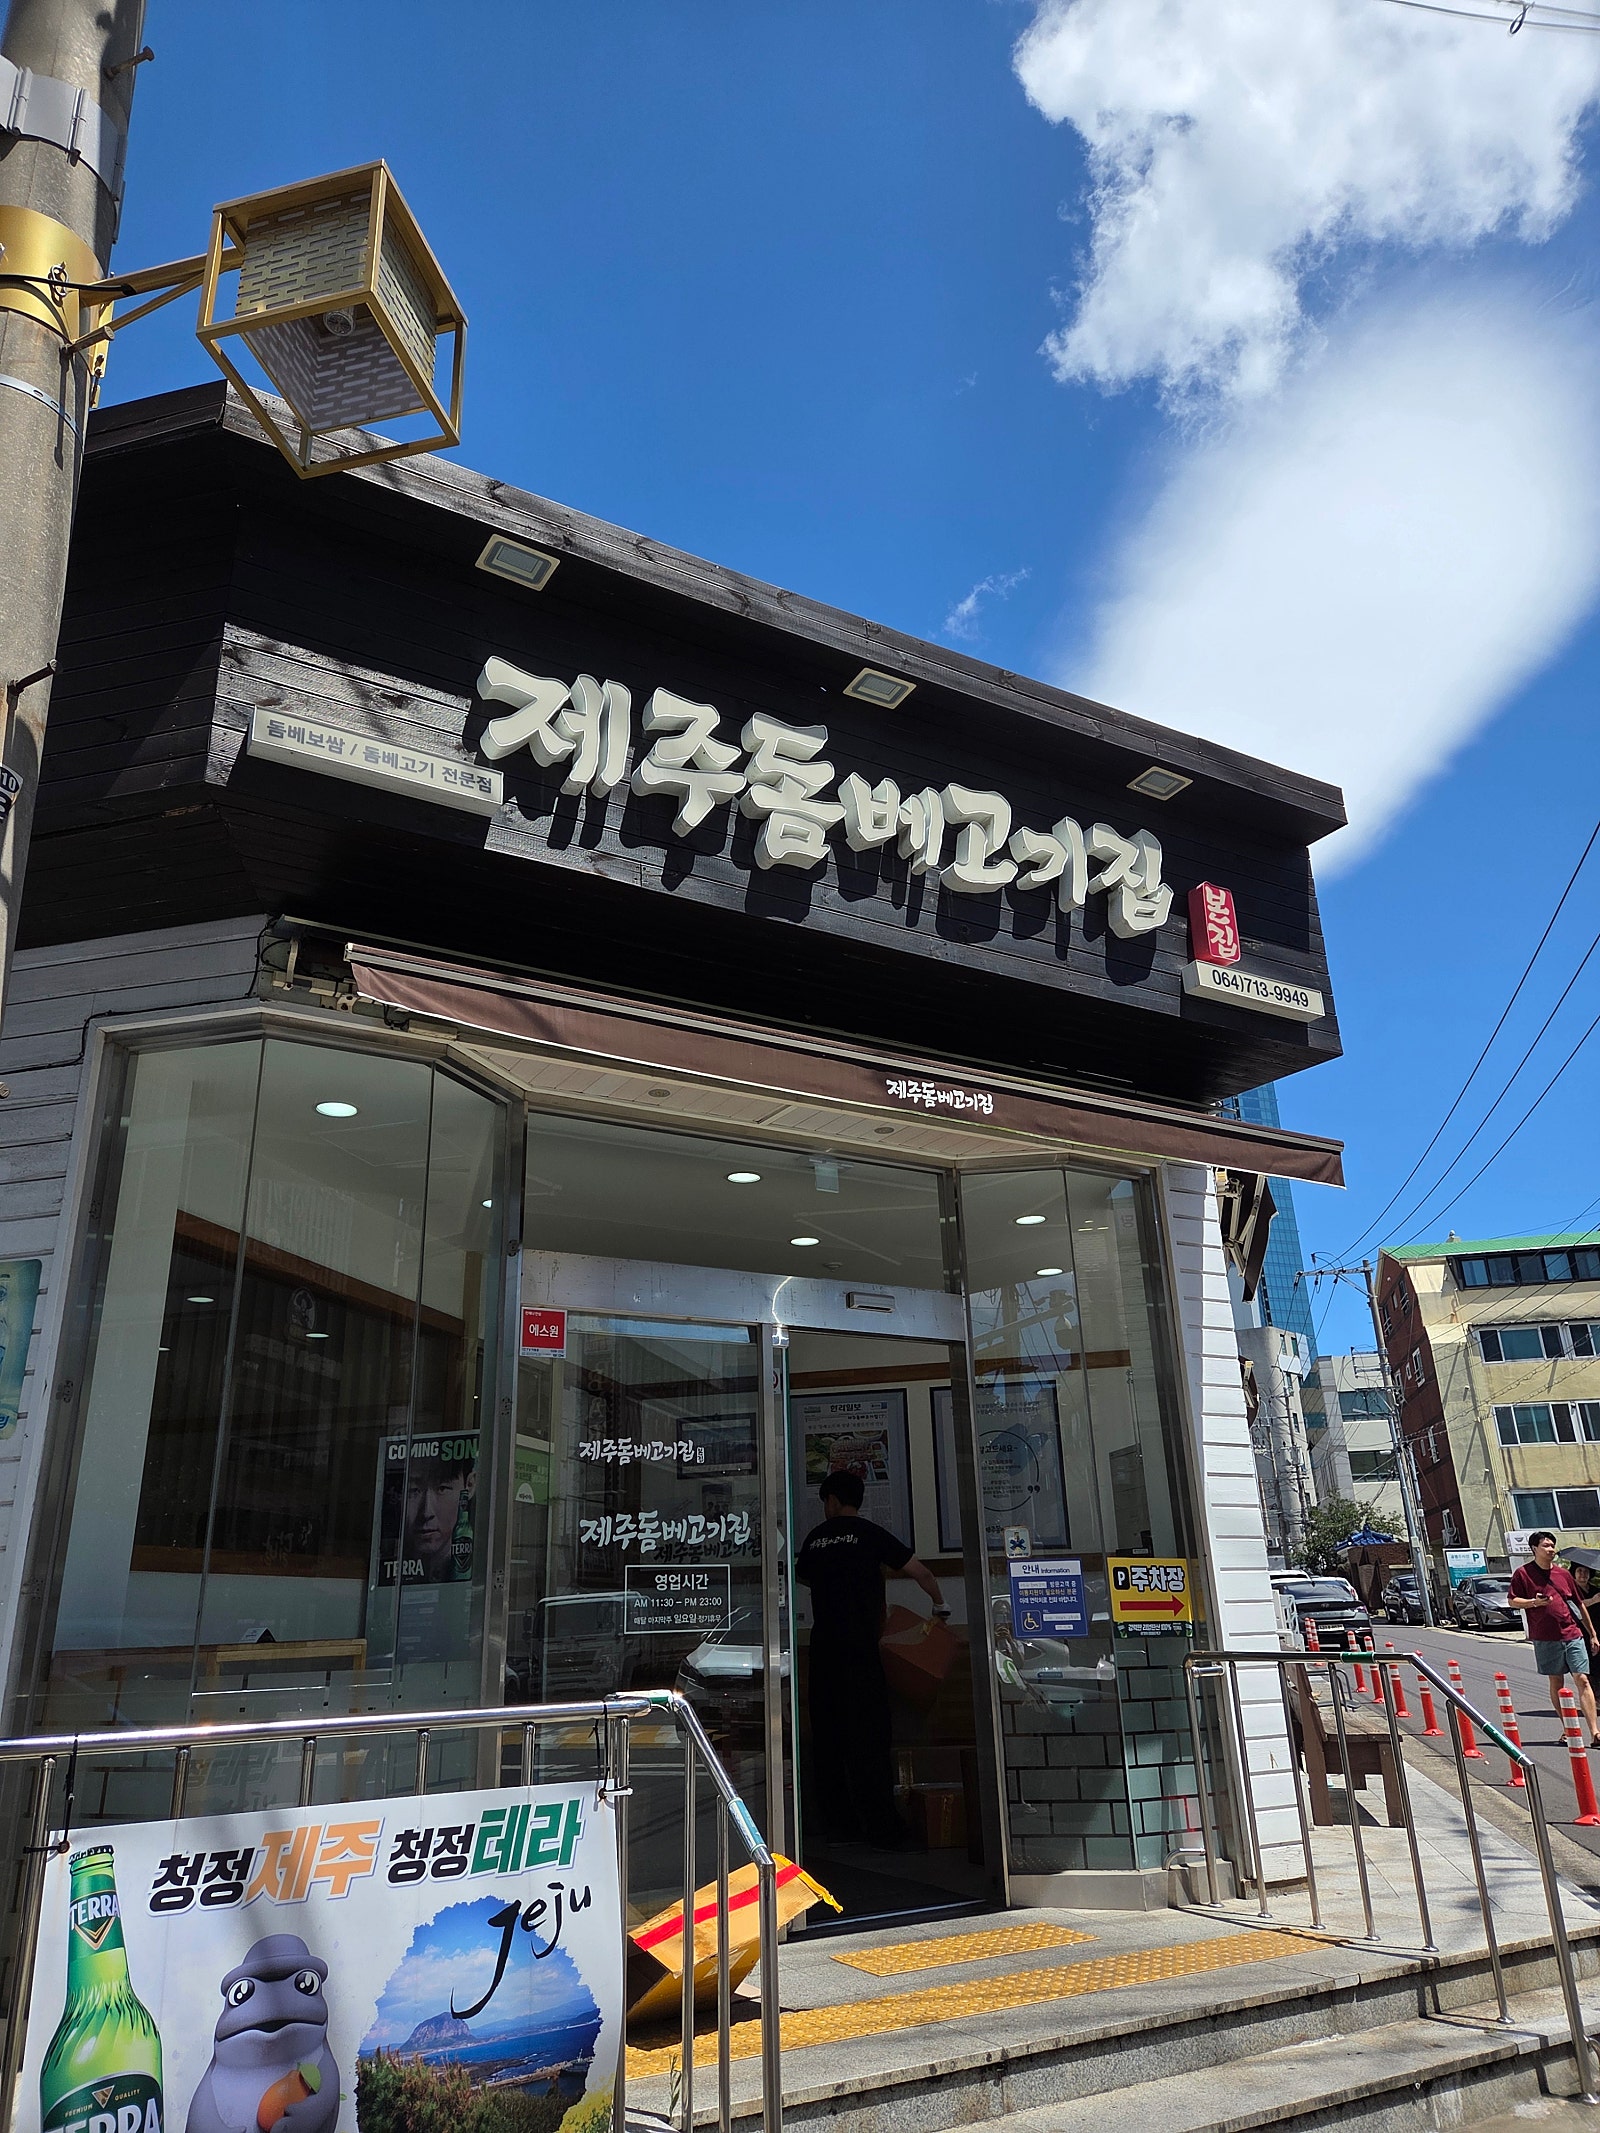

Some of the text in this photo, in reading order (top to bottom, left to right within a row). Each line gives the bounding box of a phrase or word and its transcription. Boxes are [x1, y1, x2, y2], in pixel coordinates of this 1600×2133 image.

[266, 718, 345, 755] 돔베보쌈
[362, 744, 436, 780] 돔베고기
[441, 767, 493, 794] 전문점
[476, 655, 1174, 939] 제주돔베고기집
[1204, 882, 1239, 961] 본집
[1211, 968, 1310, 1009] 064)713-9949
[886, 1078, 994, 1115] 제주돔베고기집
[529, 1324, 559, 1338] 에스원
[388, 1441, 440, 1461] COMING
[579, 1437, 695, 1466] 제주돔베고기집
[579, 1510, 751, 1554] 제주돔베고기집
[383, 1559, 425, 1579] TERRA
[654, 1573, 710, 1591] 영업시간
[1022, 1564, 1071, 1575] 안내 Information
[1130, 1566, 1185, 1592] 주차장
[634, 1599, 648, 1608] AM
[651, 1598, 674, 1607] 11:30
[684, 1597, 697, 1606] PM
[699, 1597, 722, 1606] 23:00
[673, 1613, 697, 1624] 일요일
[147, 1799, 585, 1914] 청정제주 청정테라
[69, 1893, 121, 1931] TERRA
[64, 2088, 141, 2118] PREMIUM QUALITY
